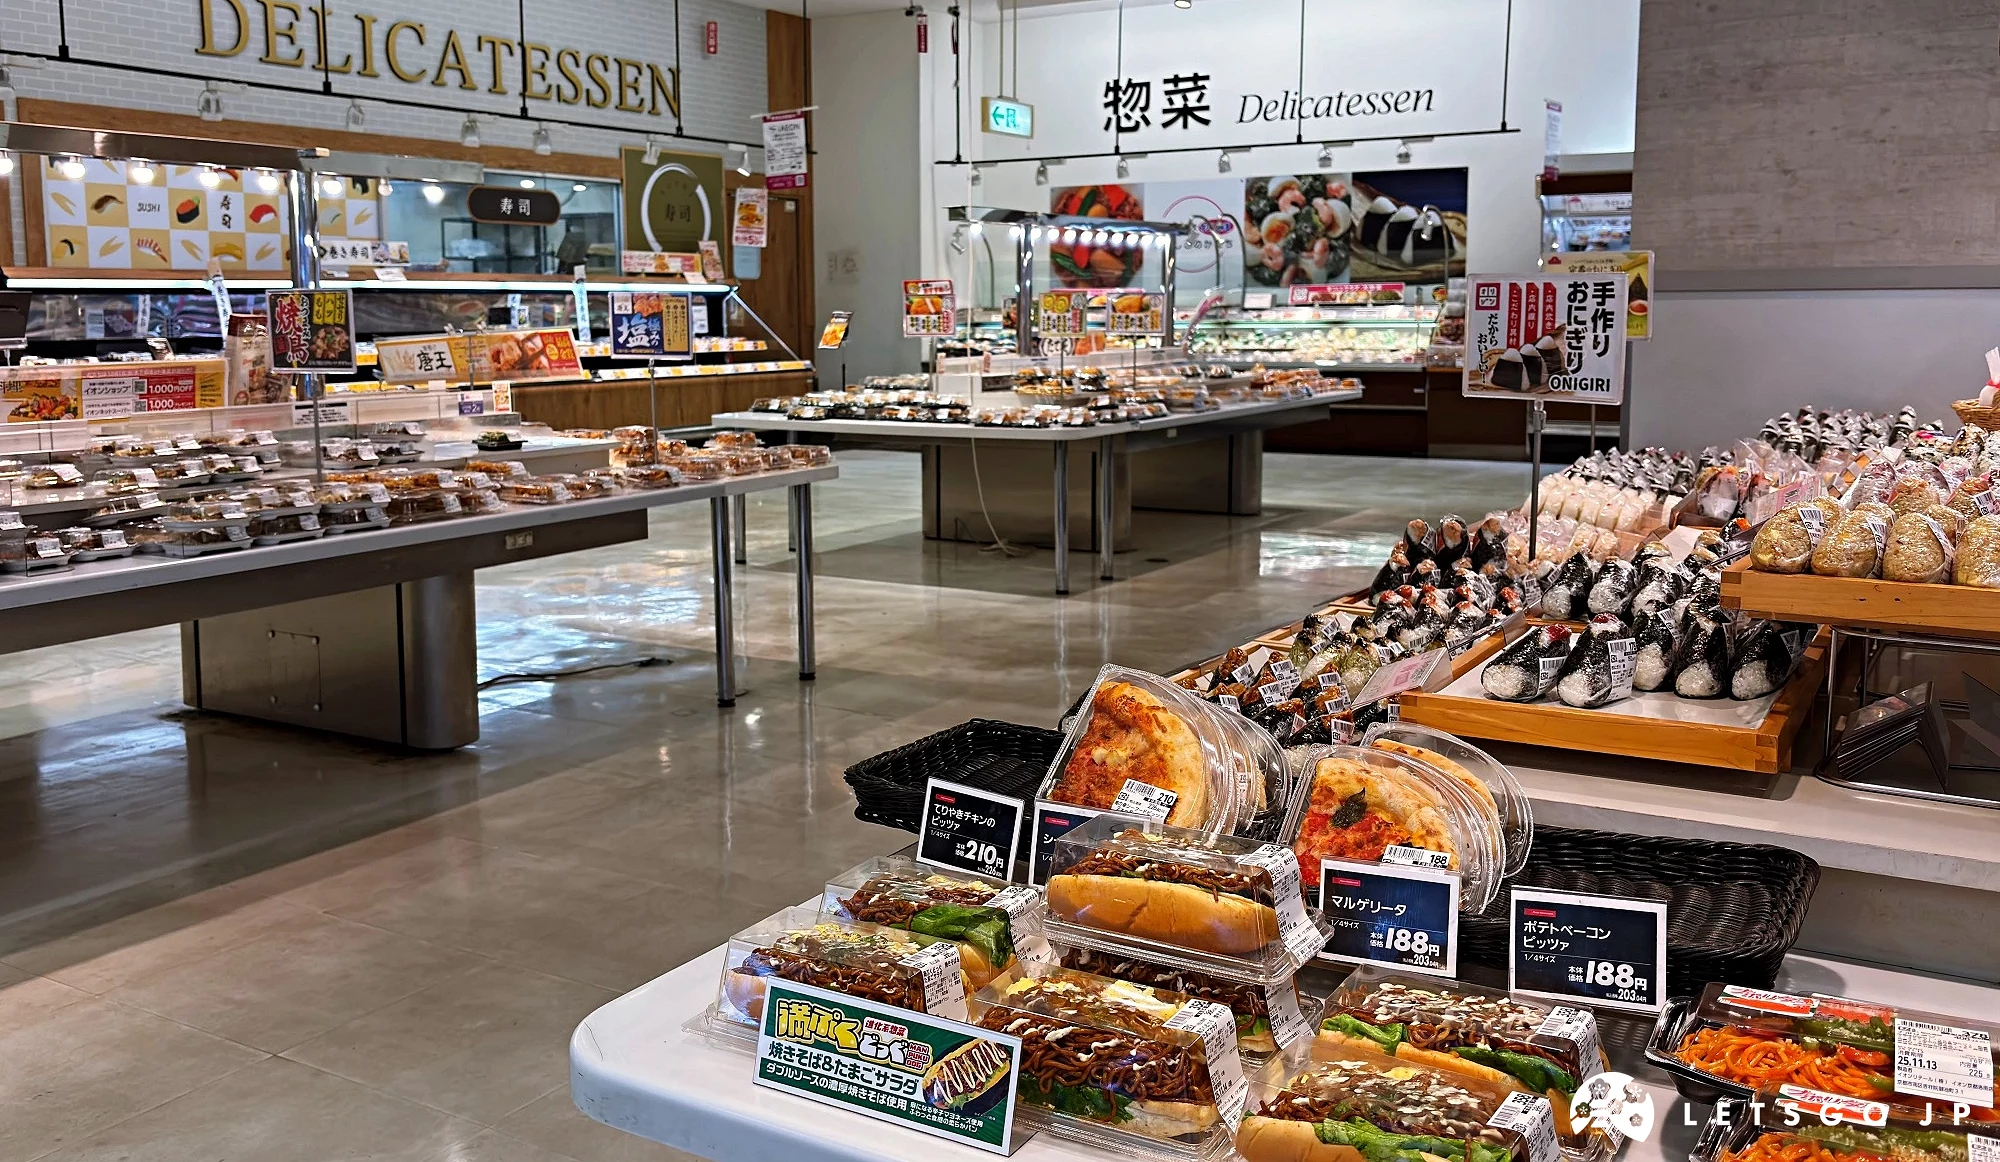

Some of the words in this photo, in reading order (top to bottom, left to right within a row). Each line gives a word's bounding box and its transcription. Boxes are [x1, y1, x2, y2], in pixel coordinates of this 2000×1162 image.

[195, 0, 680, 118] DELICATESSEN
[1104, 72, 1211, 133] 惣菜
[1236, 87, 1435, 125] Delicatessen
[136, 202, 161, 213] SUSHI
[219, 194, 232, 229] 寿司
[500, 197, 532, 217] 寿司
[328, 242, 369, 259] 巻き寿司
[1566, 280, 1589, 375] おにぎり
[1591, 280, 1616, 358] 手作り
[275, 295, 310, 364] 焼鳥
[617, 312, 651, 348] 塩
[1487, 313, 1500, 347] だから
[1550, 375, 1611, 393] ONIGIRI
[1157, 793, 1174, 804] 210
[931, 815, 960, 831] ピッツァ
[933, 803, 996, 828] てりやきチキンの
[964, 840, 1004, 869] 210円
[1430, 854, 1448, 865] 188
[1331, 894, 1407, 917] マルゲリータ
[1330, 919, 1360, 930] 1/4サイズ
[1523, 920, 1612, 940] ポテトベーコン
[1369, 939, 1384, 948] 価格
[1370, 931, 1384, 940] 本体
[1385, 927, 1440, 957] 188円
[1523, 935, 1570, 951] ピッツァ
[1524, 953, 1556, 963] 1/4サイズ
[1568, 965, 1584, 974] 本体
[1568, 974, 1584, 983] 価格
[1585, 960, 1648, 991] 188円
[865, 1019, 906, 1037] 進化系惣菜
[907, 1051, 930, 1063] PUKU
[908, 1042, 929, 1054] MAN
[768, 1040, 920, 1096] 焼きそば&たまごサラダ
[906, 1059, 923, 1070] DOG
[1897, 1055, 1938, 1070] 25.11.13
[1968, 1068, 1983, 1078] 225
[766, 1063, 908, 1111] ダブルソースの濃厚焼きそば使用
